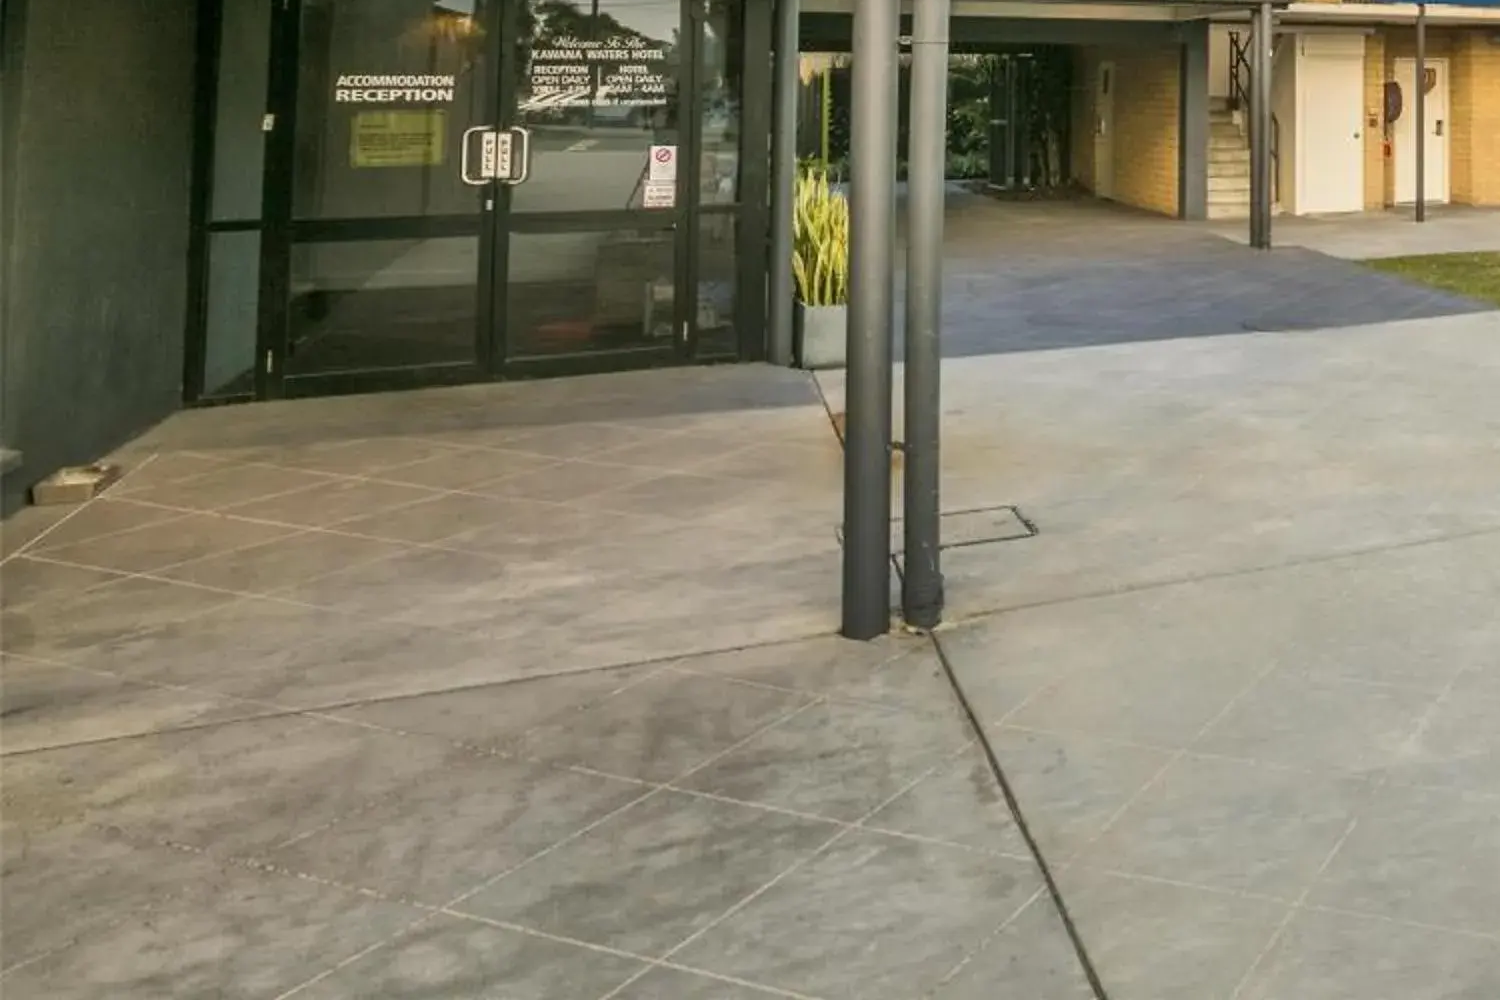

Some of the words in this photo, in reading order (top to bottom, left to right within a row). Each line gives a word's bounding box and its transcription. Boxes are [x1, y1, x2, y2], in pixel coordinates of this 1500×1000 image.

[587, 50, 629, 60] WATERS
[631, 50, 665, 60] HOTEL
[533, 65, 589, 74] RECEPTION
[336, 75, 455, 87] ACCOMMODATION
[335, 88, 454, 101] RECEPTION
[485, 139, 493, 171] PULL
[501, 139, 509, 171] PULL
